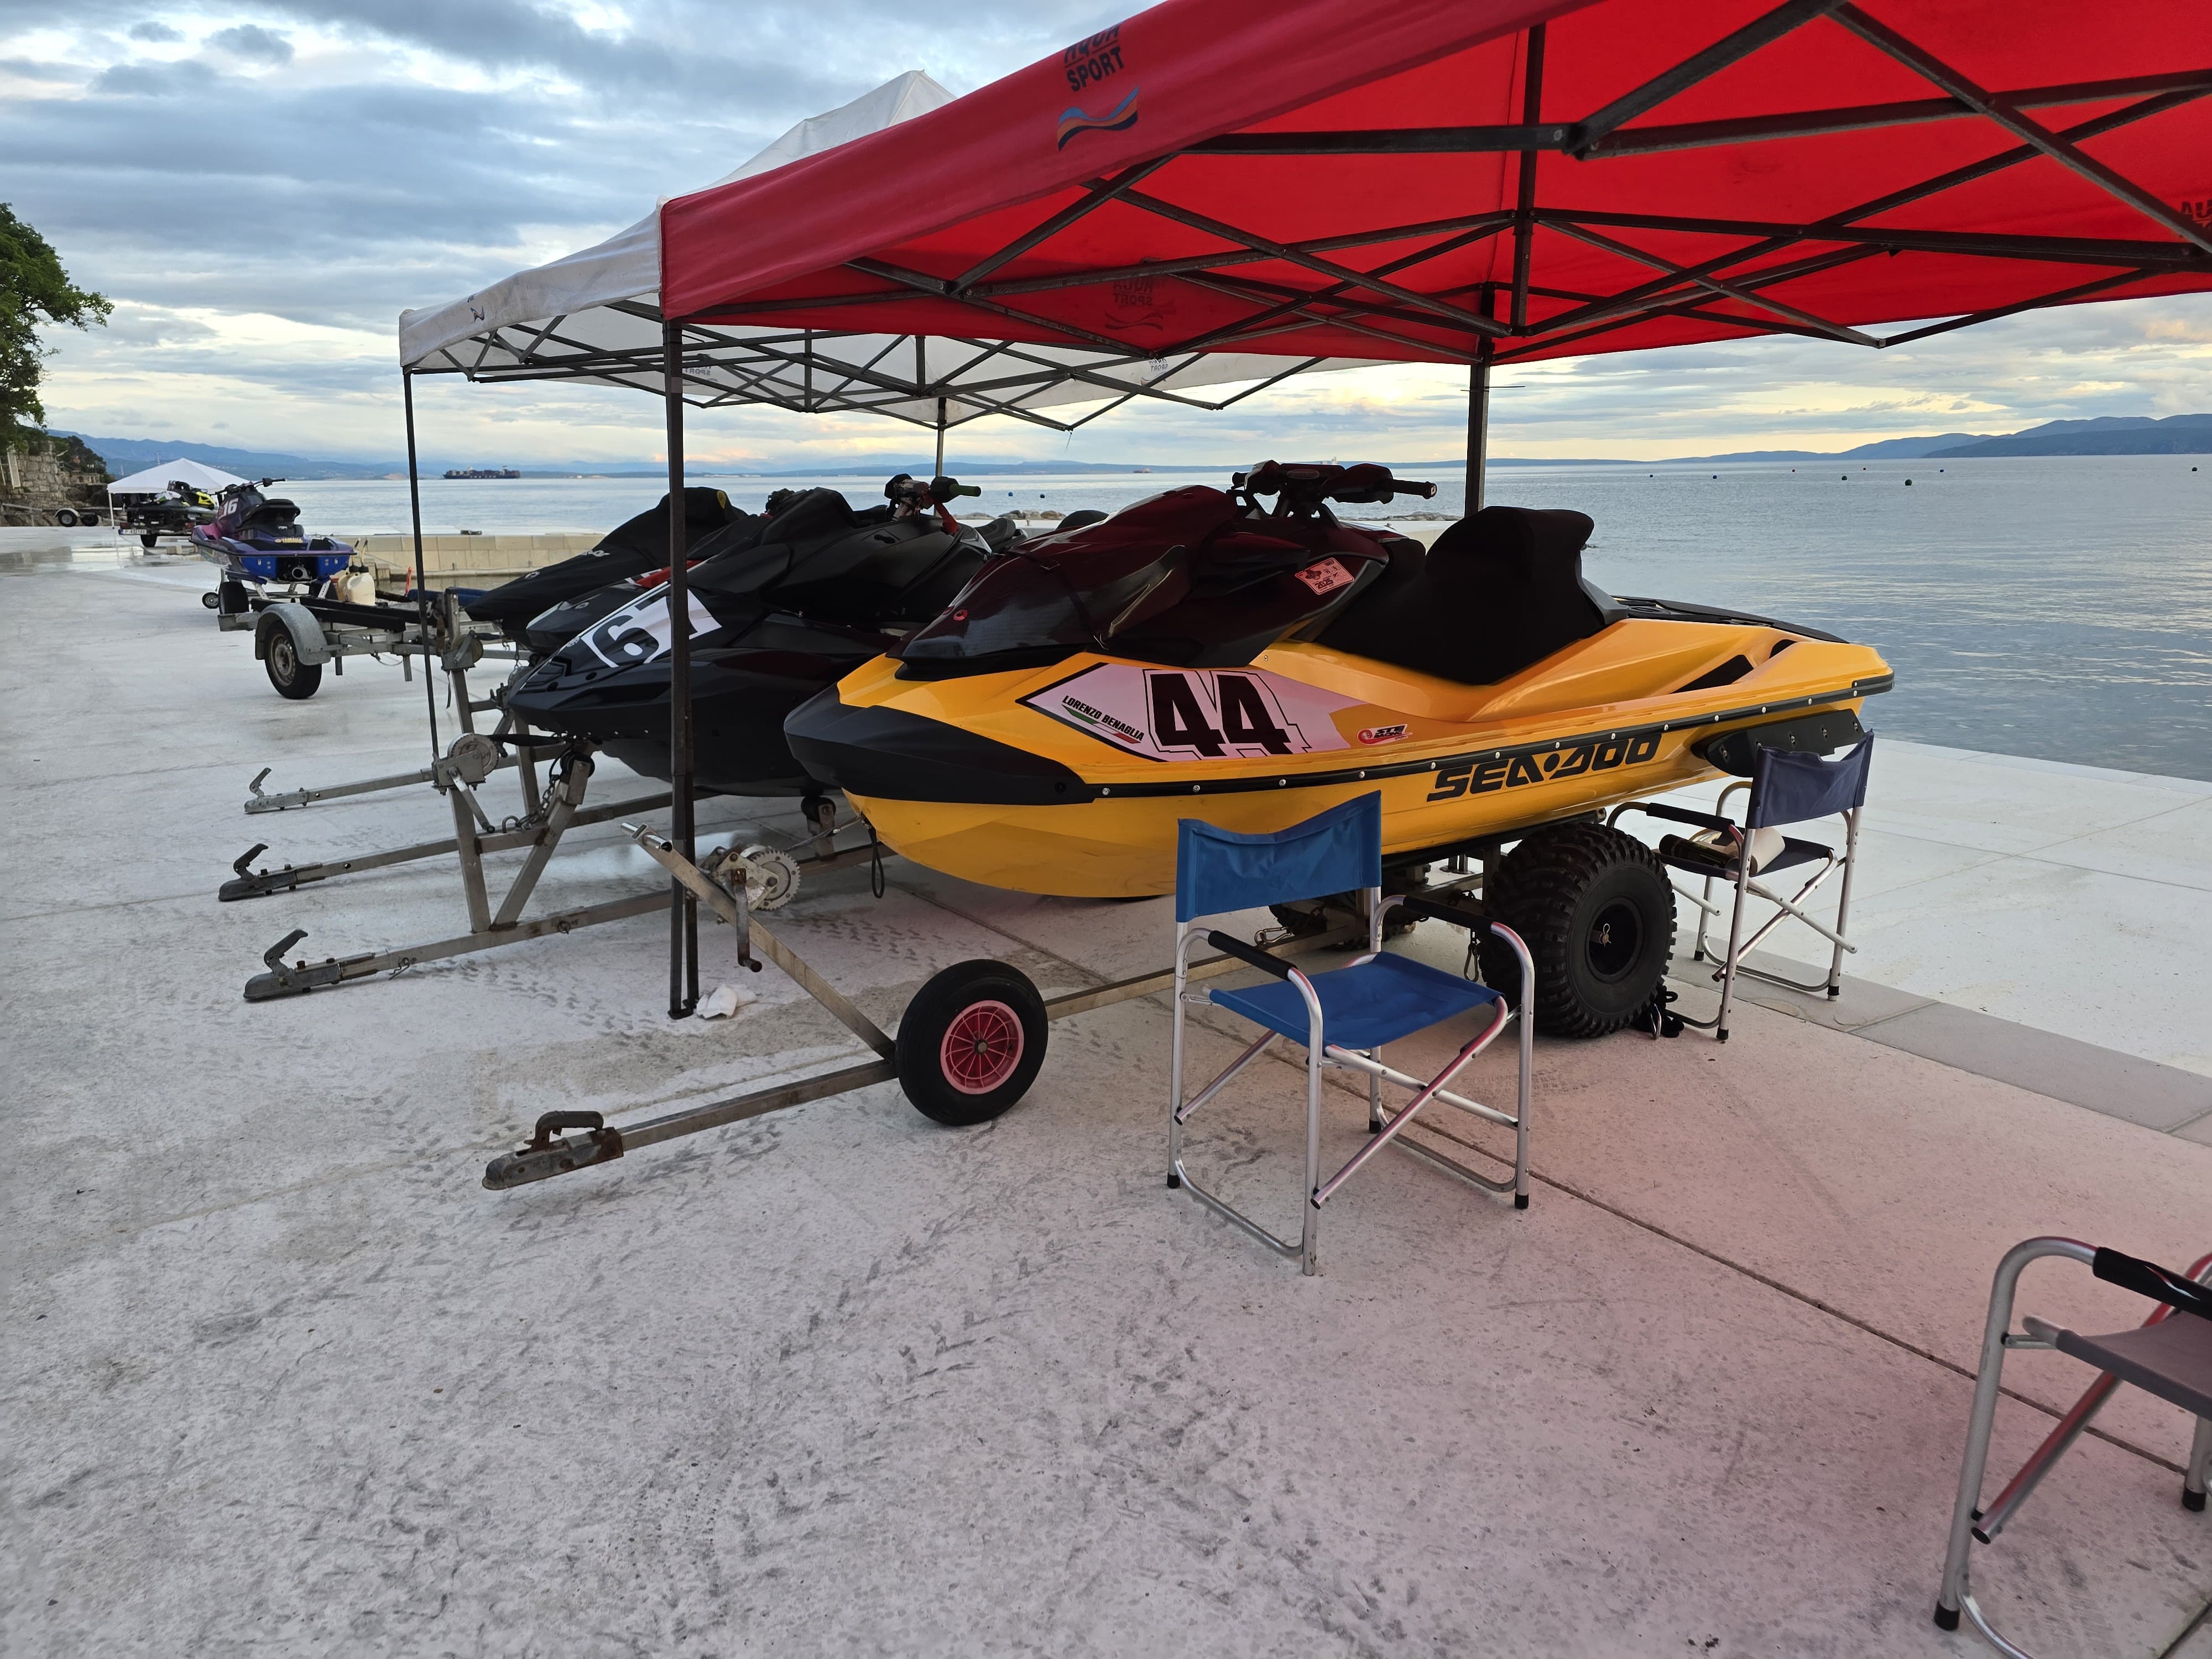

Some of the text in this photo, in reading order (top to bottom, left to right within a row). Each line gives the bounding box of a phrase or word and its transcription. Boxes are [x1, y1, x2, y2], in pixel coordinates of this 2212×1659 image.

[1067, 46, 1124, 91] SPORT
[1314, 577, 1334, 589] 2025
[1062, 695, 1145, 741] LORENZO BENAGLIA
[1150, 673, 1294, 757] 44
